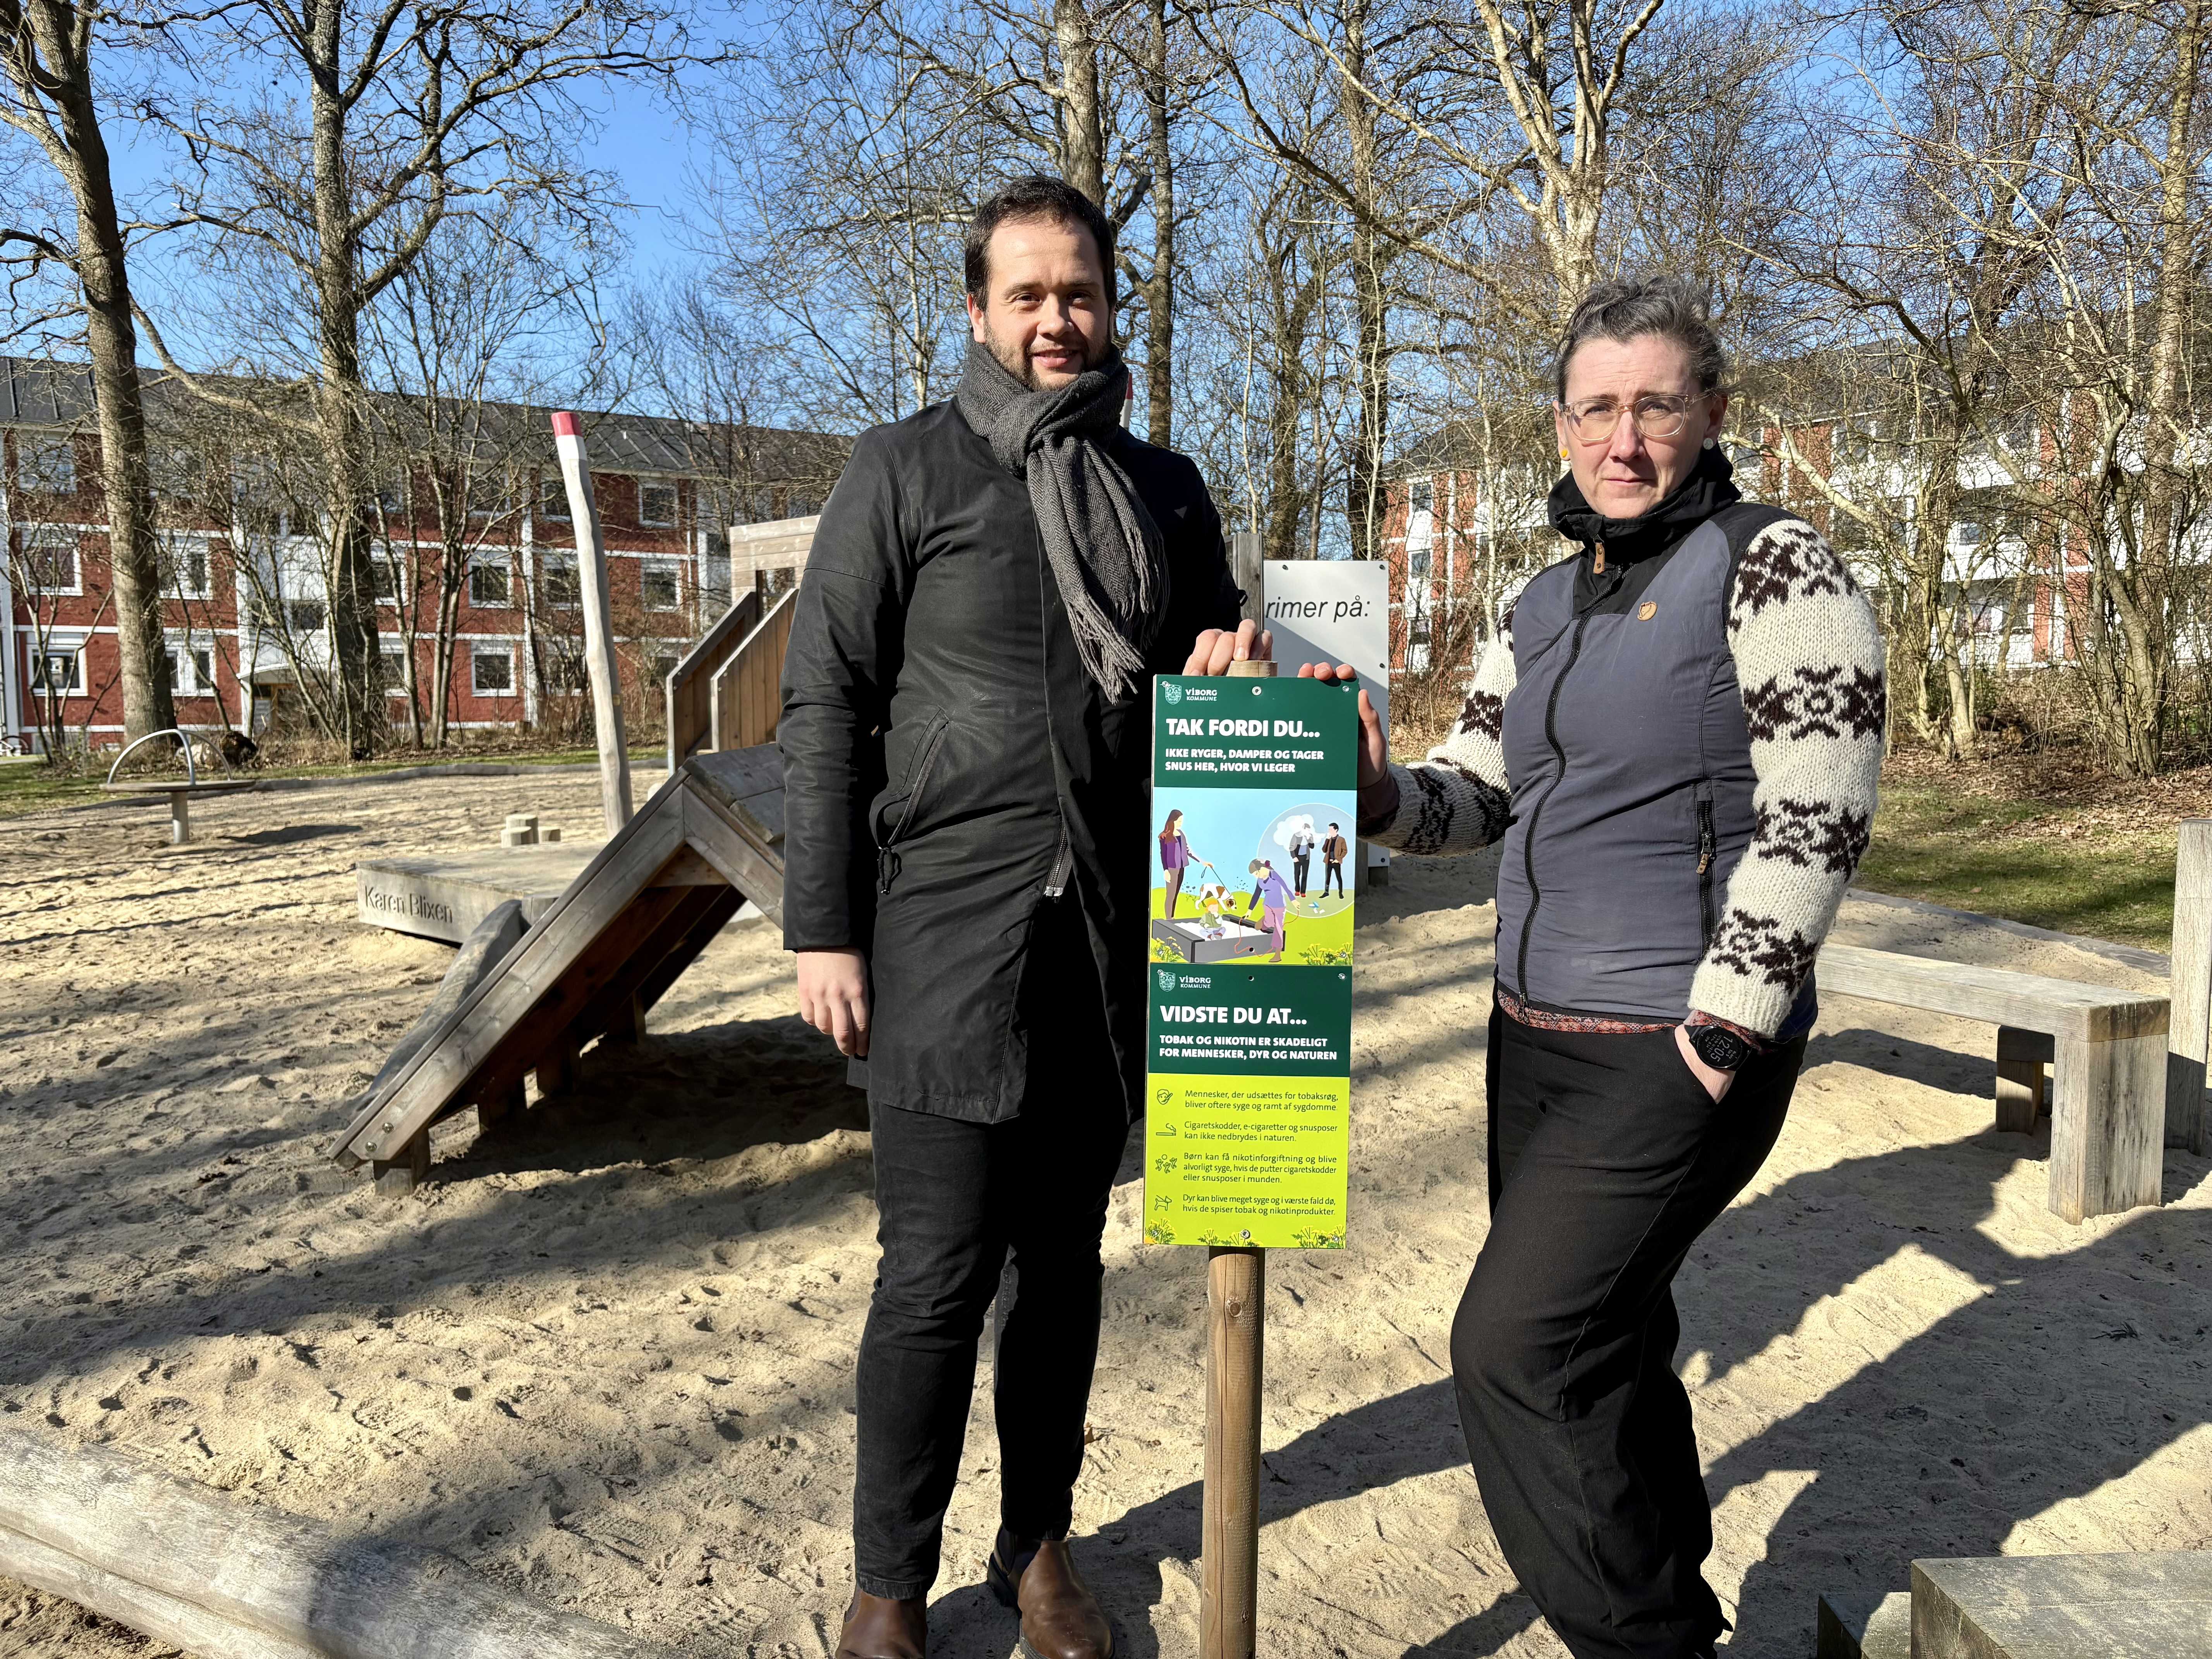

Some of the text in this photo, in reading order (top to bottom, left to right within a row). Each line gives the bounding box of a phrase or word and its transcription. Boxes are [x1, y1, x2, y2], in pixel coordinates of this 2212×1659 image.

[1265, 595, 1370, 623] rimer på:
[1166, 718, 1320, 738] TAK FORDI DU...
[1165, 748, 1324, 760] IKKE RYGER, DAMPER OG TAGER
[1165, 761, 1295, 773] SNUS HER, HVOR VI LEGER
[365, 885, 453, 924] Karen Blixen
[1159, 1005, 1307, 1025] VIDSTE DU AT...
[1159, 1034, 1328, 1047] TOBAK OG NIKOTIN ER SKADELIGT
[1159, 1048, 1337, 1060] FOR MENNESKER, DYR OG NATUREN
[1710, 1036, 1733, 1062] 12:05
[1185, 1089, 1230, 1099] Mennesker,
[1247, 1091, 1283, 1099] udsættes
[1285, 1091, 1296, 1099] for
[1298, 1092, 1338, 1103] tobaksrøg,
[1185, 1099, 1207, 1108] bliver
[1208, 1100, 1231, 1109] oftere
[1233, 1103, 1250, 1111] syge
[1252, 1103, 1262, 1112] og
[1283, 1102, 1292, 1110] af
[1184, 1121, 1338, 1133] Cigaretskodder, e-cigaretter og snusposer
[1184, 1131, 1198, 1139] kan
[1200, 1132, 1216, 1140] ikke
[1218, 1132, 1257, 1143] nedbrydes
[1184, 1152, 1337, 1165] Børn kan få nikotinforgiftning og blive
[1183, 1162, 1337, 1175] alvorligt syge, hvis de putter cigaretskodder
[1183, 1173, 1200, 1181] eller
[1202, 1175, 1242, 1183] snusposer
[1183, 1194, 1196, 1204] Dyr
[1197, 1194, 1209, 1202] kan
[1211, 1194, 1228, 1203] blive
[1229, 1195, 1252, 1206] meget
[1254, 1197, 1269, 1206] syge
[1271, 1197, 1280, 1206] og
[1310, 1197, 1324, 1205] fald
[1325, 1197, 1336, 1206] dø,
[1183, 1204, 1198, 1212] hvis
[1199, 1204, 1209, 1212] de
[1211, 1205, 1233, 1215] spiser
[1235, 1206, 1257, 1214] tobak
[1258, 1208, 1268, 1216] og
